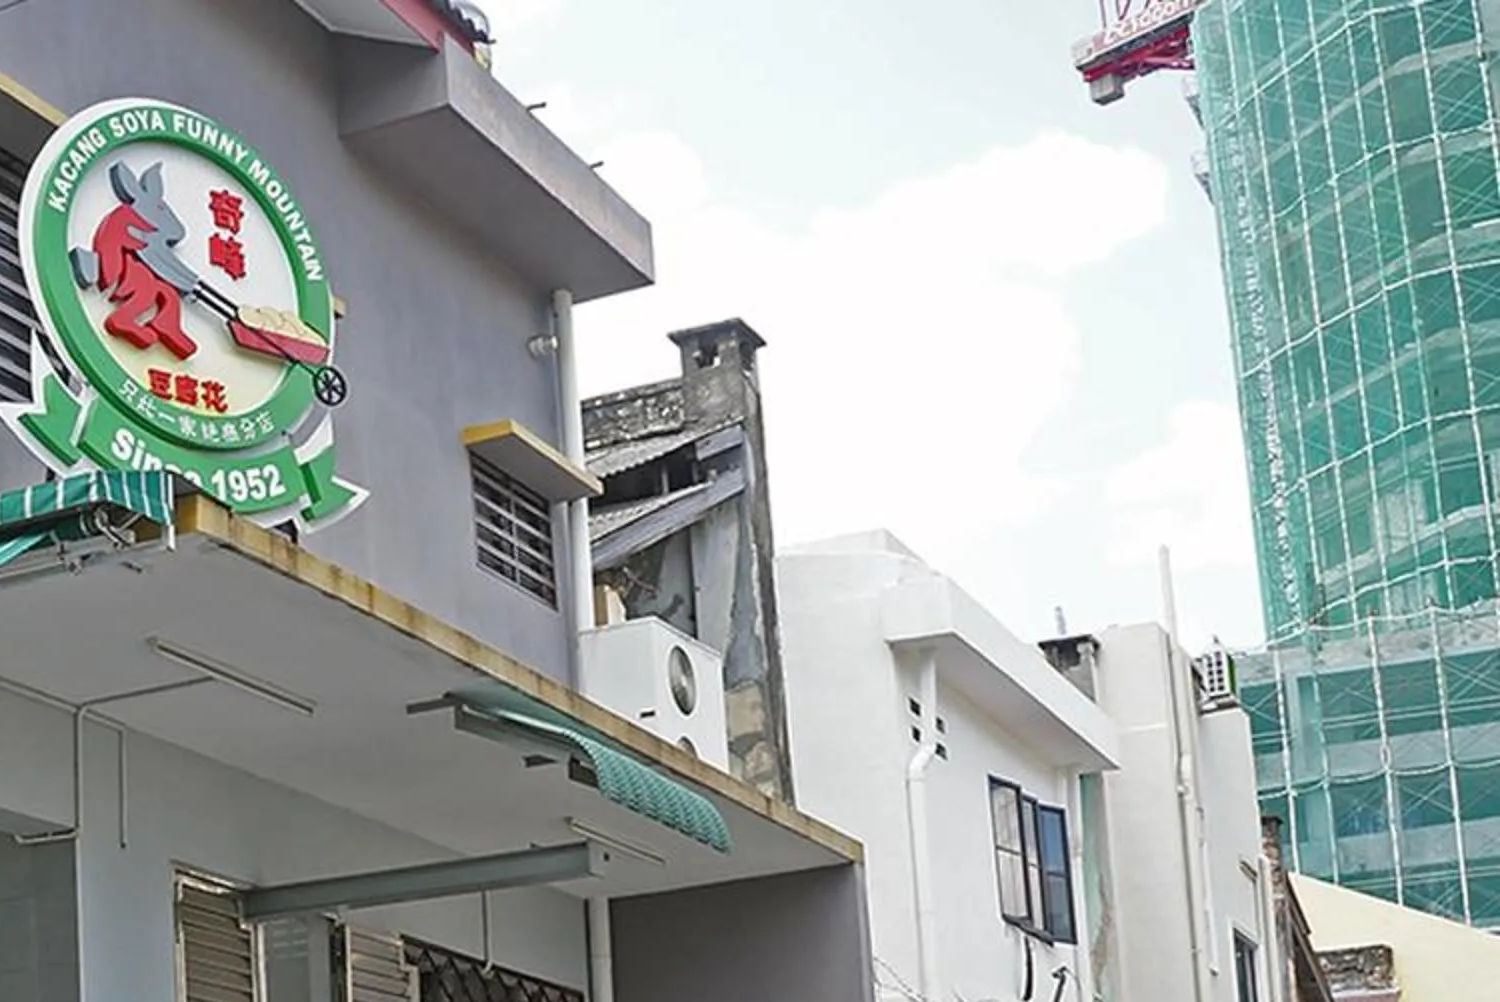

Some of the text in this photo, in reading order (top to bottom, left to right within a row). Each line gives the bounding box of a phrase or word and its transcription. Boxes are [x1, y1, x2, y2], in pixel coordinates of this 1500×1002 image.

[48, 110, 323, 281] KACANG SOYA FUNNY MOUNTAIN
[208, 190, 247, 281] 奇峰
[148, 368, 229, 414] 豆腐花
[211, 464, 287, 503] 1952
